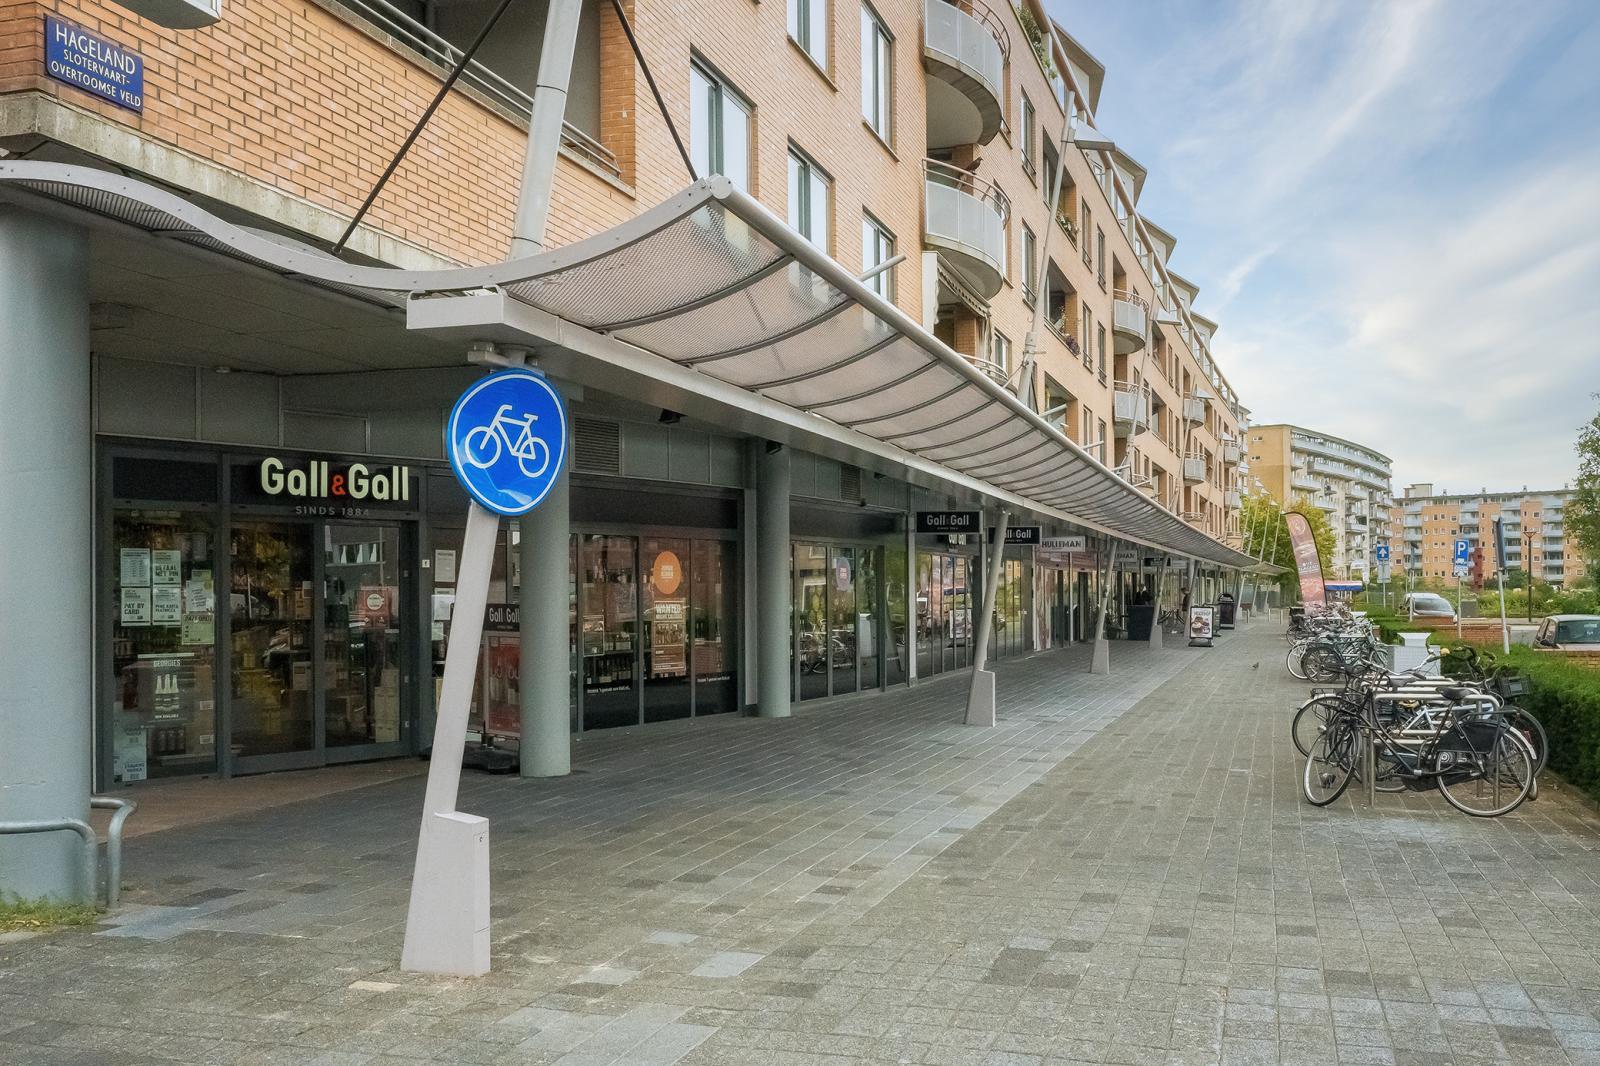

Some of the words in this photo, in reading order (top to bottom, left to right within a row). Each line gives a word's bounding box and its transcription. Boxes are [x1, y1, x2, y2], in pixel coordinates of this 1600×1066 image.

[56, 23, 136, 75] HAGELAND
[63, 49, 130, 85] SLOTERVAART-
[51, 60, 117, 97] OVERTOOMSE
[120, 89, 141, 107] VELD
[295, 505, 336, 516] SINDS
[341, 507, 370, 517] 1884
[1457, 541, 1466, 555] P
